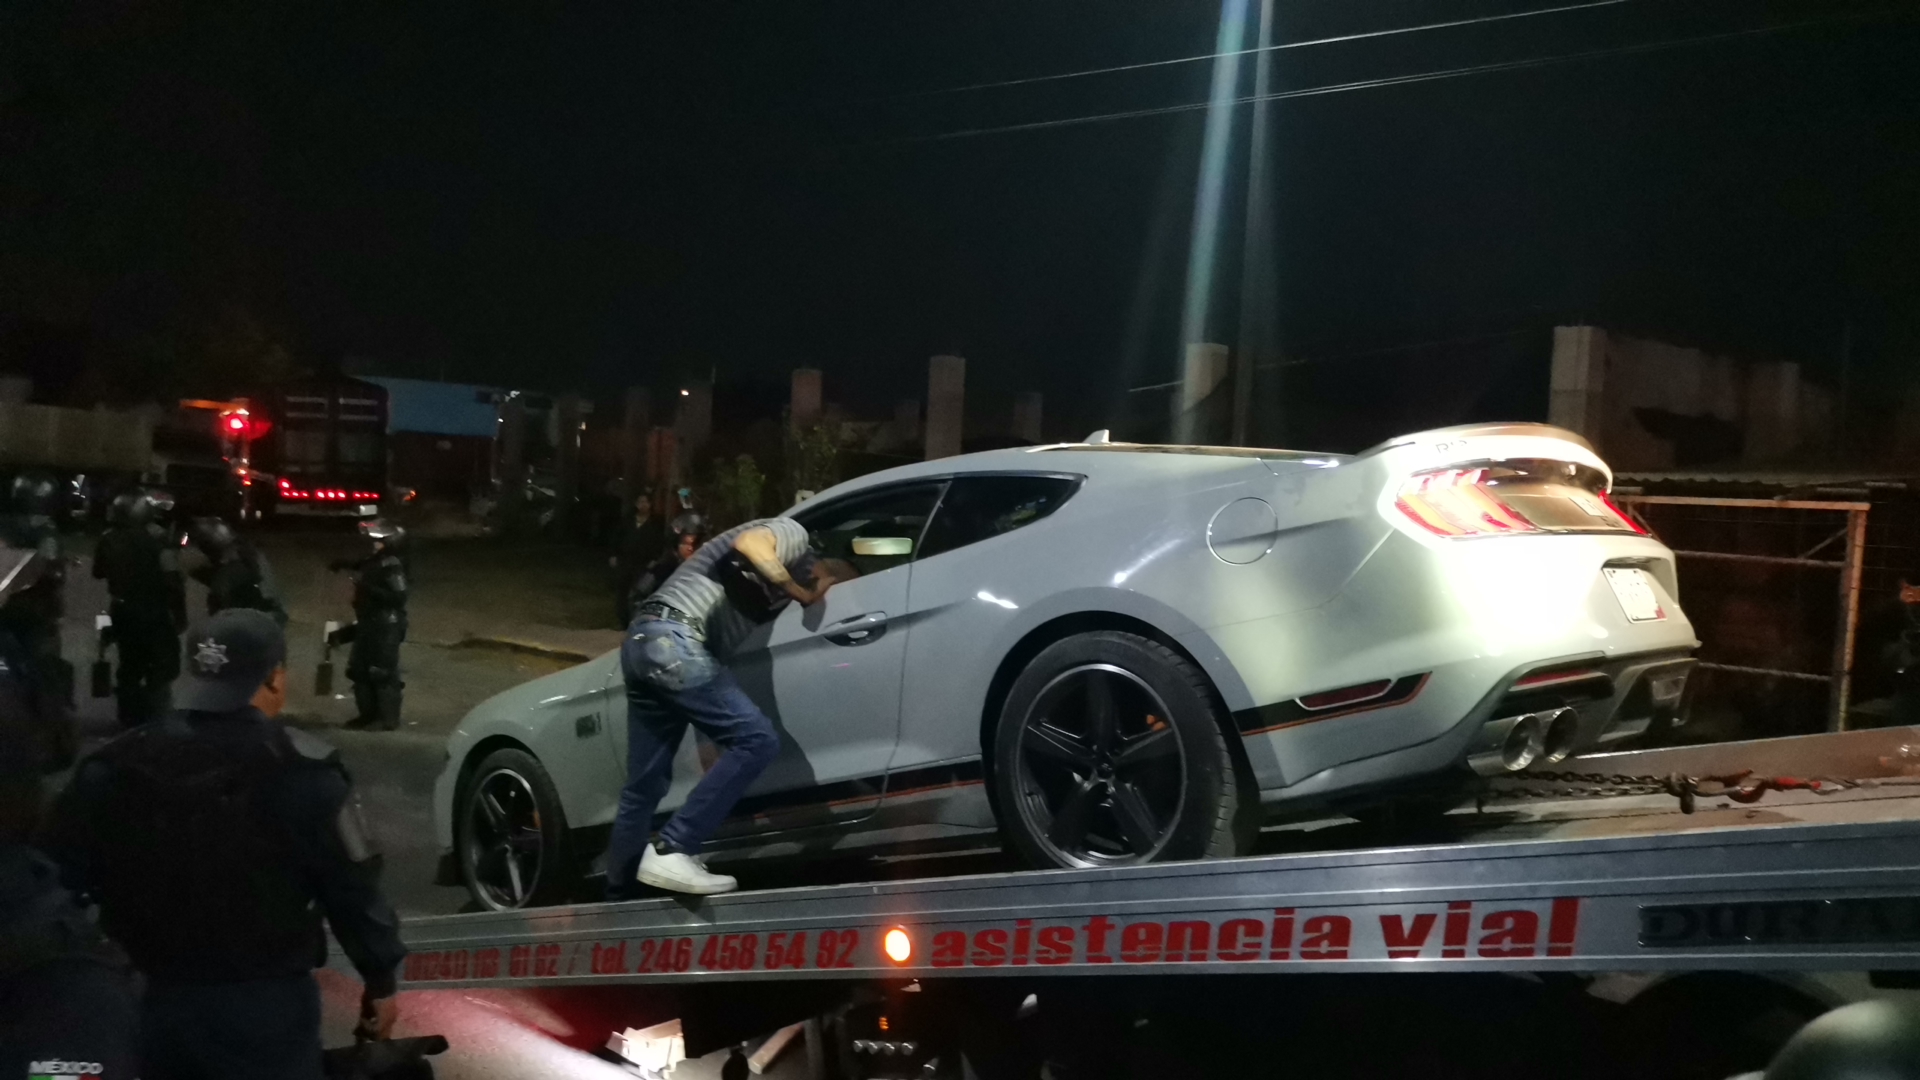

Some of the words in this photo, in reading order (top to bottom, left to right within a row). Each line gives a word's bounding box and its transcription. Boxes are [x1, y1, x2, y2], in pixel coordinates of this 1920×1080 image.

[637, 937, 693, 973] 246
[698, 933, 758, 971] 458
[764, 932, 807, 970] 54
[816, 929, 862, 969] 92
[931, 907, 1352, 968] asistencia
[1379, 896, 1580, 959] vial
[28, 1058, 104, 1074] MÉXICO
